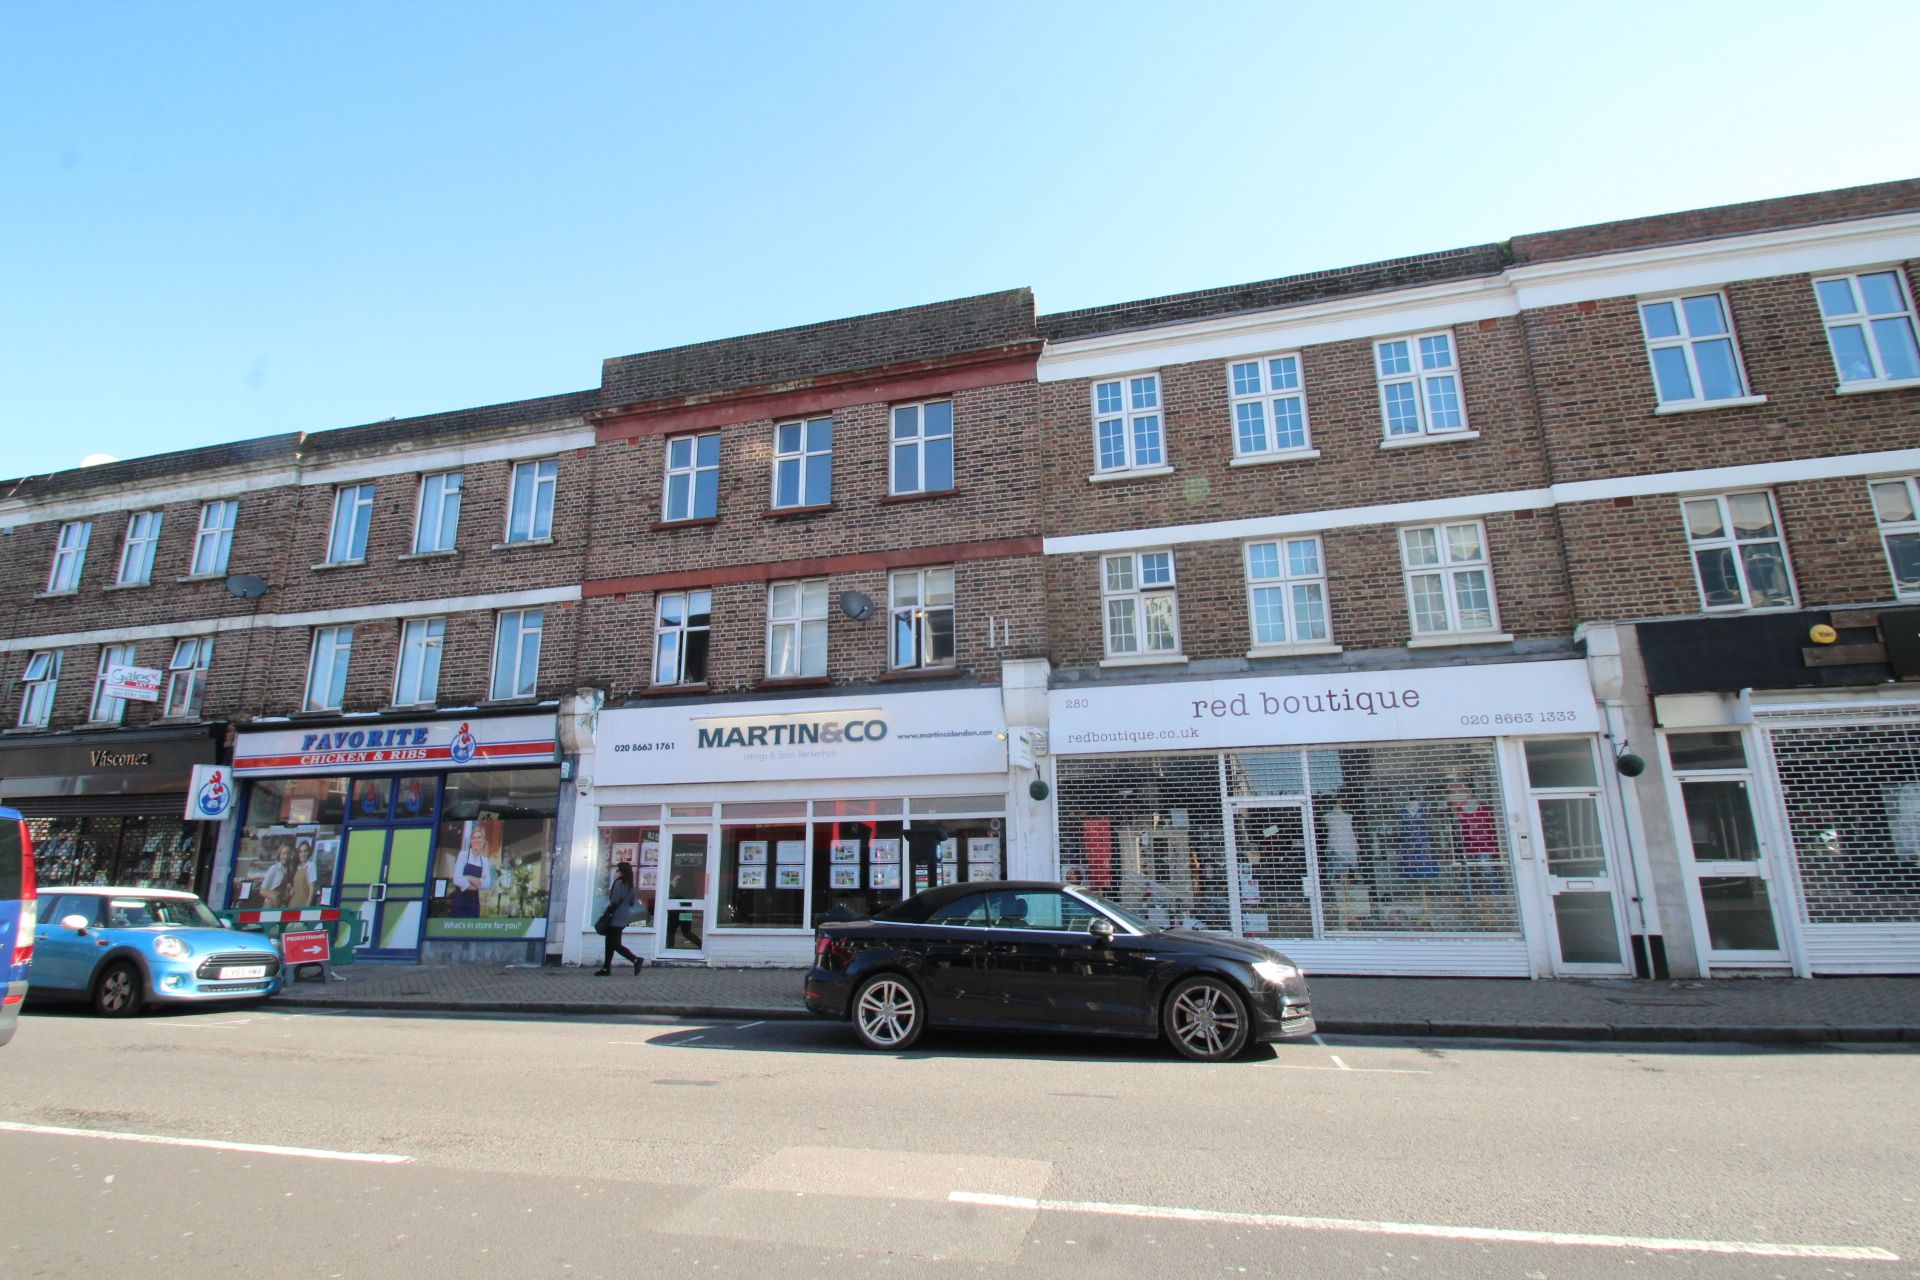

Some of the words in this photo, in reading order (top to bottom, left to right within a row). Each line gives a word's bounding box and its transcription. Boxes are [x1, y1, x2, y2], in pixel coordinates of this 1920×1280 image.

[1065, 698, 1089, 709] 280
[1192, 693, 1250, 718] red
[1259, 688, 1420, 716] boutique
[1460, 714, 1490, 725] 020
[1494, 713, 1534, 724] 8663
[1538, 711, 1577, 722] 1333
[301, 727, 429, 751] FAVORITE
[698, 719, 888, 749] MARTIN&CO
[1067, 727, 1200, 743] redboutique.co.uk
[614, 744, 630, 752] 020
[632, 743, 653, 751] 8663
[655, 742, 675, 750] 1761
[90, 749, 149, 767] Vásconez
[300, 751, 368, 766] CHICKEN
[373, 750, 384, 761] &
[390, 749, 427, 760] RIBS
[443, 921, 466, 929] What's
[467, 921, 474, 929] in
[475, 921, 493, 929] store
[494, 921, 504, 929] for
[504, 921, 522, 931] you?
[286, 933, 325, 942] PEDESTRIANS
